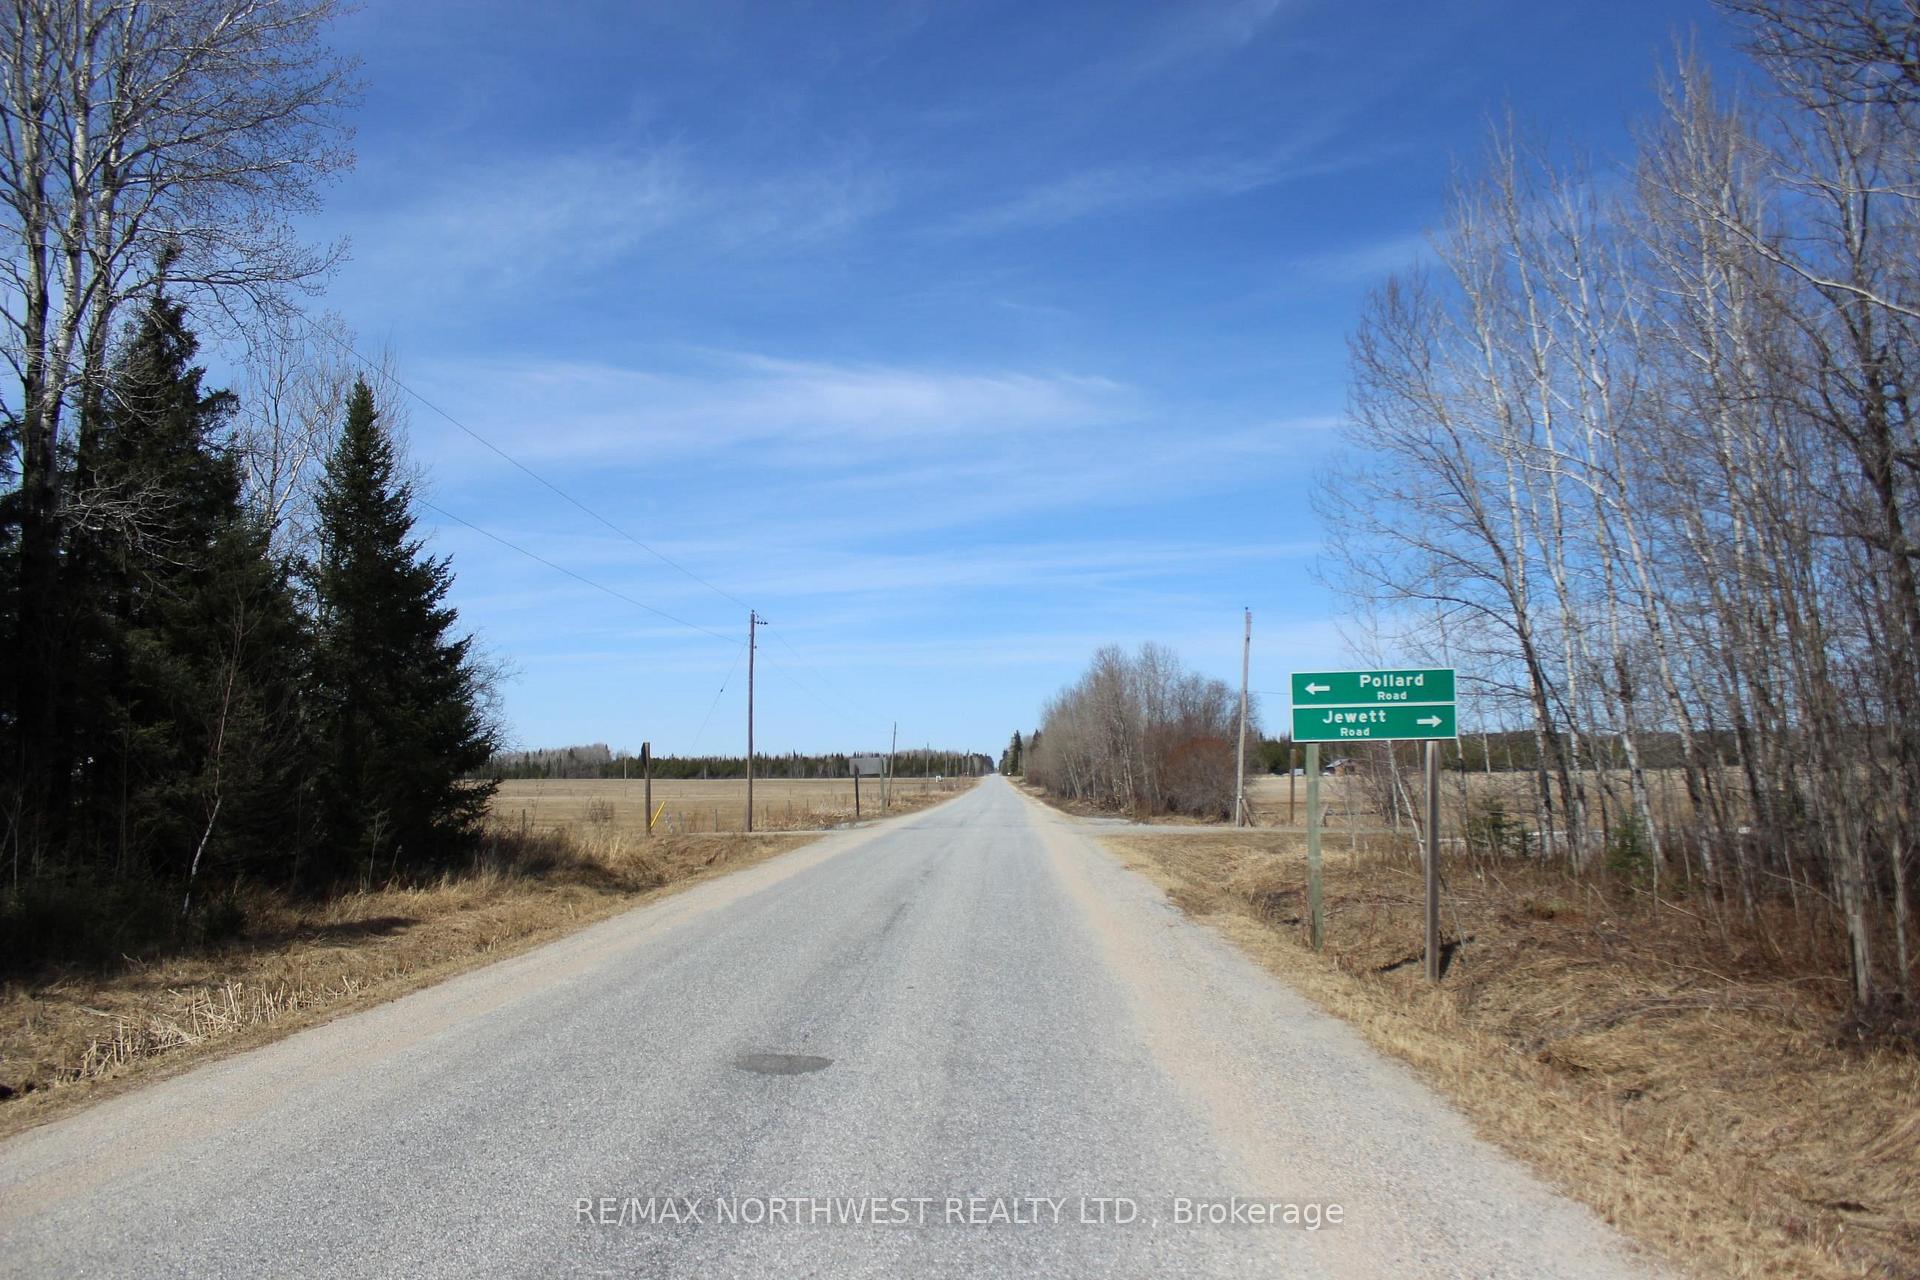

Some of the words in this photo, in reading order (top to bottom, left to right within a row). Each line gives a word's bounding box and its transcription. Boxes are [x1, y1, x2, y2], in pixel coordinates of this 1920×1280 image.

[1359, 674, 1425, 688] Pollard
[1377, 691, 1407, 700] Road
[1322, 710, 1387, 724] Jewett
[1340, 728, 1370, 737] Road
